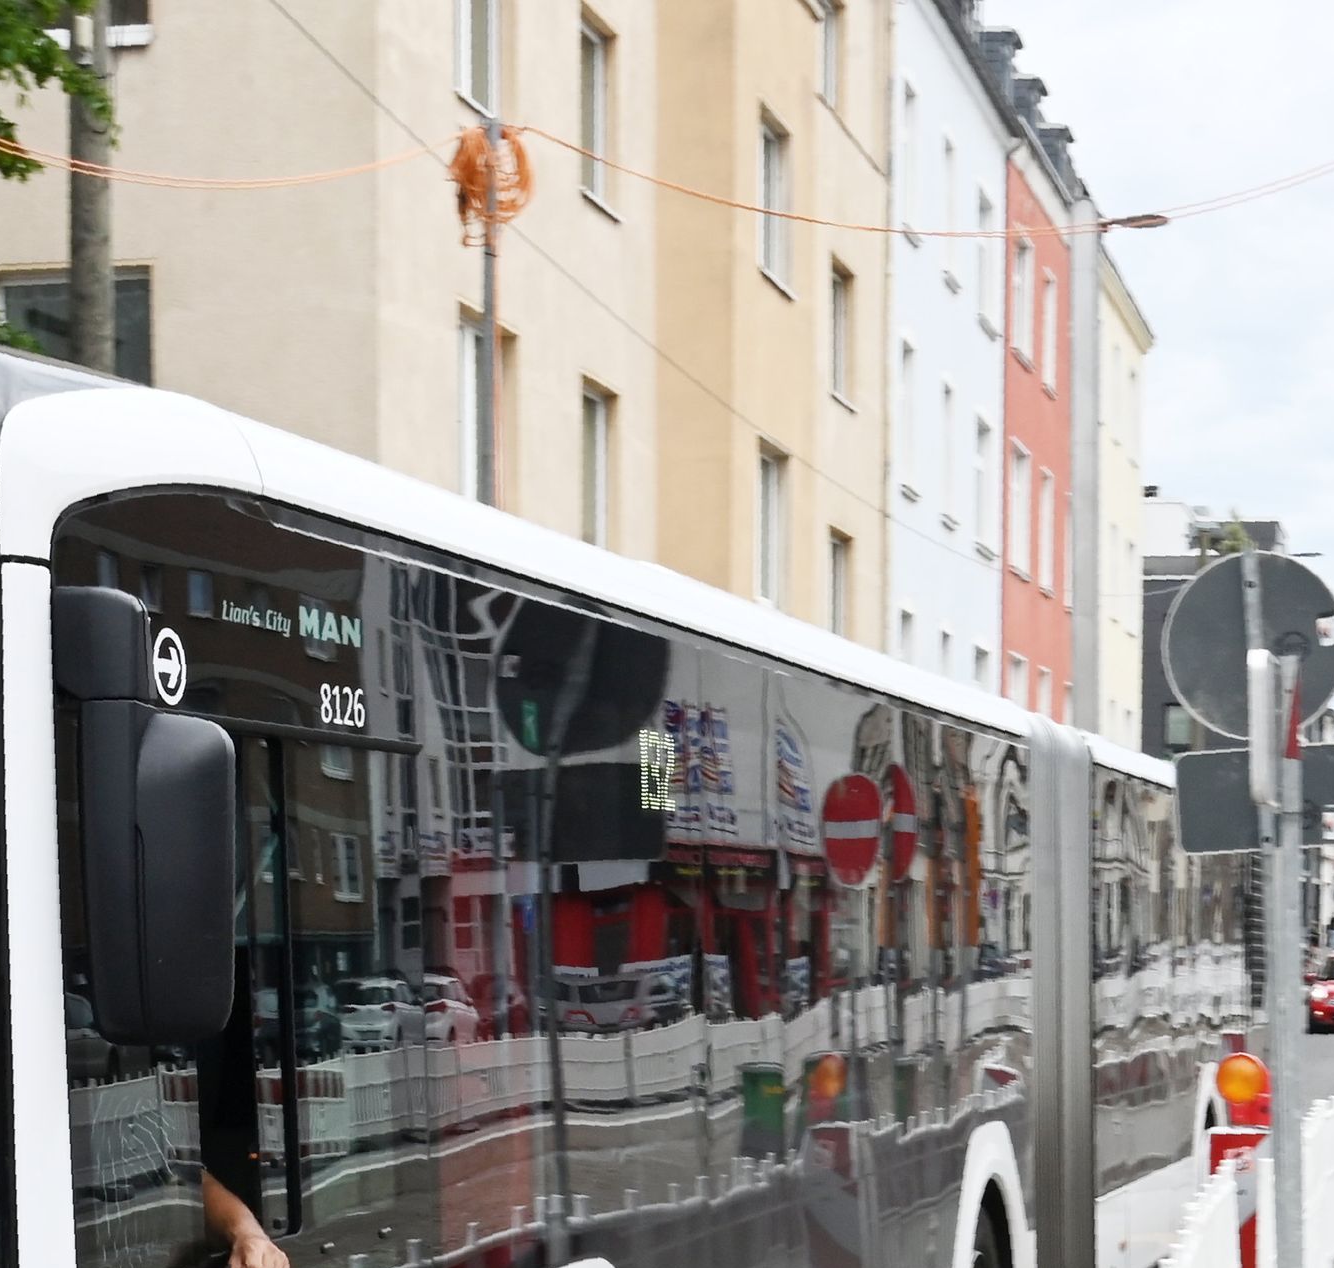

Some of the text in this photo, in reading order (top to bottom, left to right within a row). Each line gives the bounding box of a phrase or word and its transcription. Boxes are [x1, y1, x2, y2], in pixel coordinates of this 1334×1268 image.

[221, 600, 363, 648] Lion's City MAN
[320, 683, 366, 728] 8126
